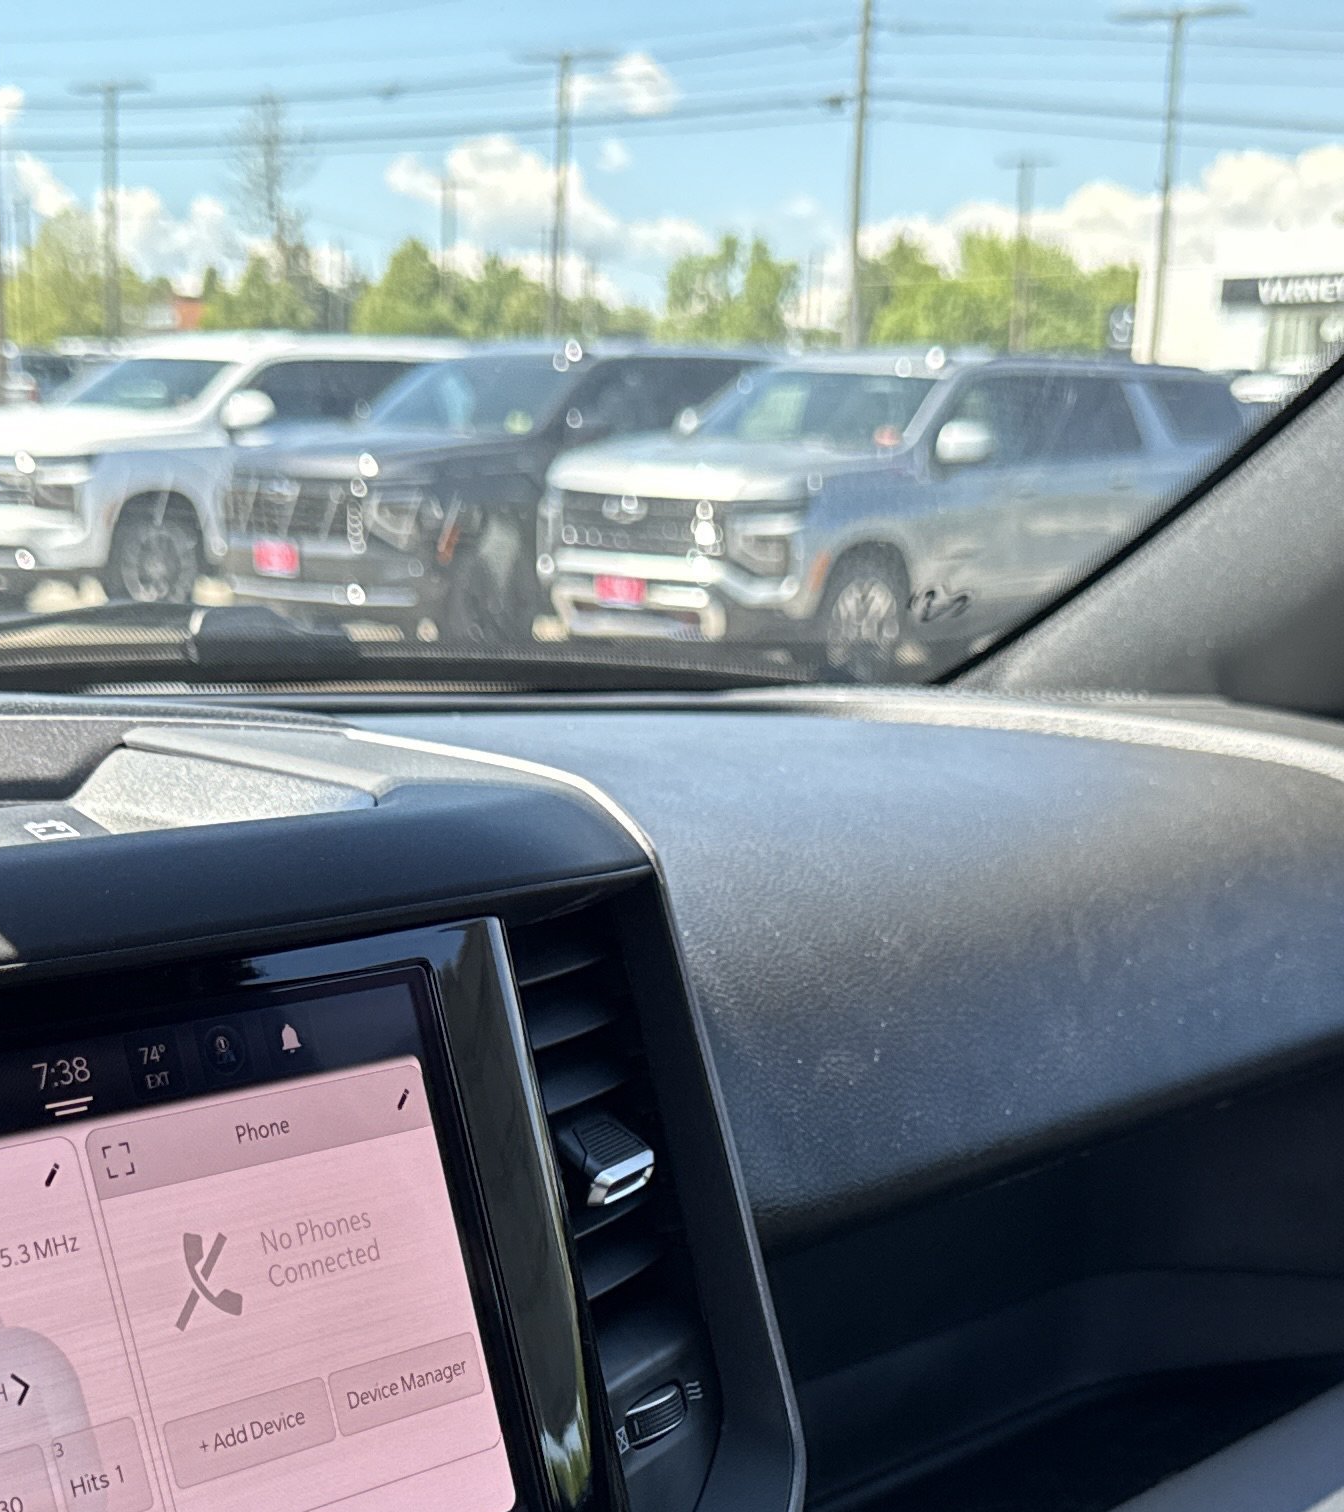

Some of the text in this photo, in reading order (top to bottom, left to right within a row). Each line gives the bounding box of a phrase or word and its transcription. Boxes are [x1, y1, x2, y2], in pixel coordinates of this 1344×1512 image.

[138, 1043, 167, 1065] 74°
[32, 1057, 91, 1091] 7:38
[146, 1070, 171, 1090] EXT
[235, 1118, 291, 1145] Phone
[33, 1234, 81, 1262] MHz
[260, 1210, 373, 1256] No Phones
[268, 1238, 382, 1288] Connected
[346, 1359, 468, 1411] Device Manager
[214, 1409, 306, 1453] Add Device
[70, 1464, 125, 1498] Hits 1
